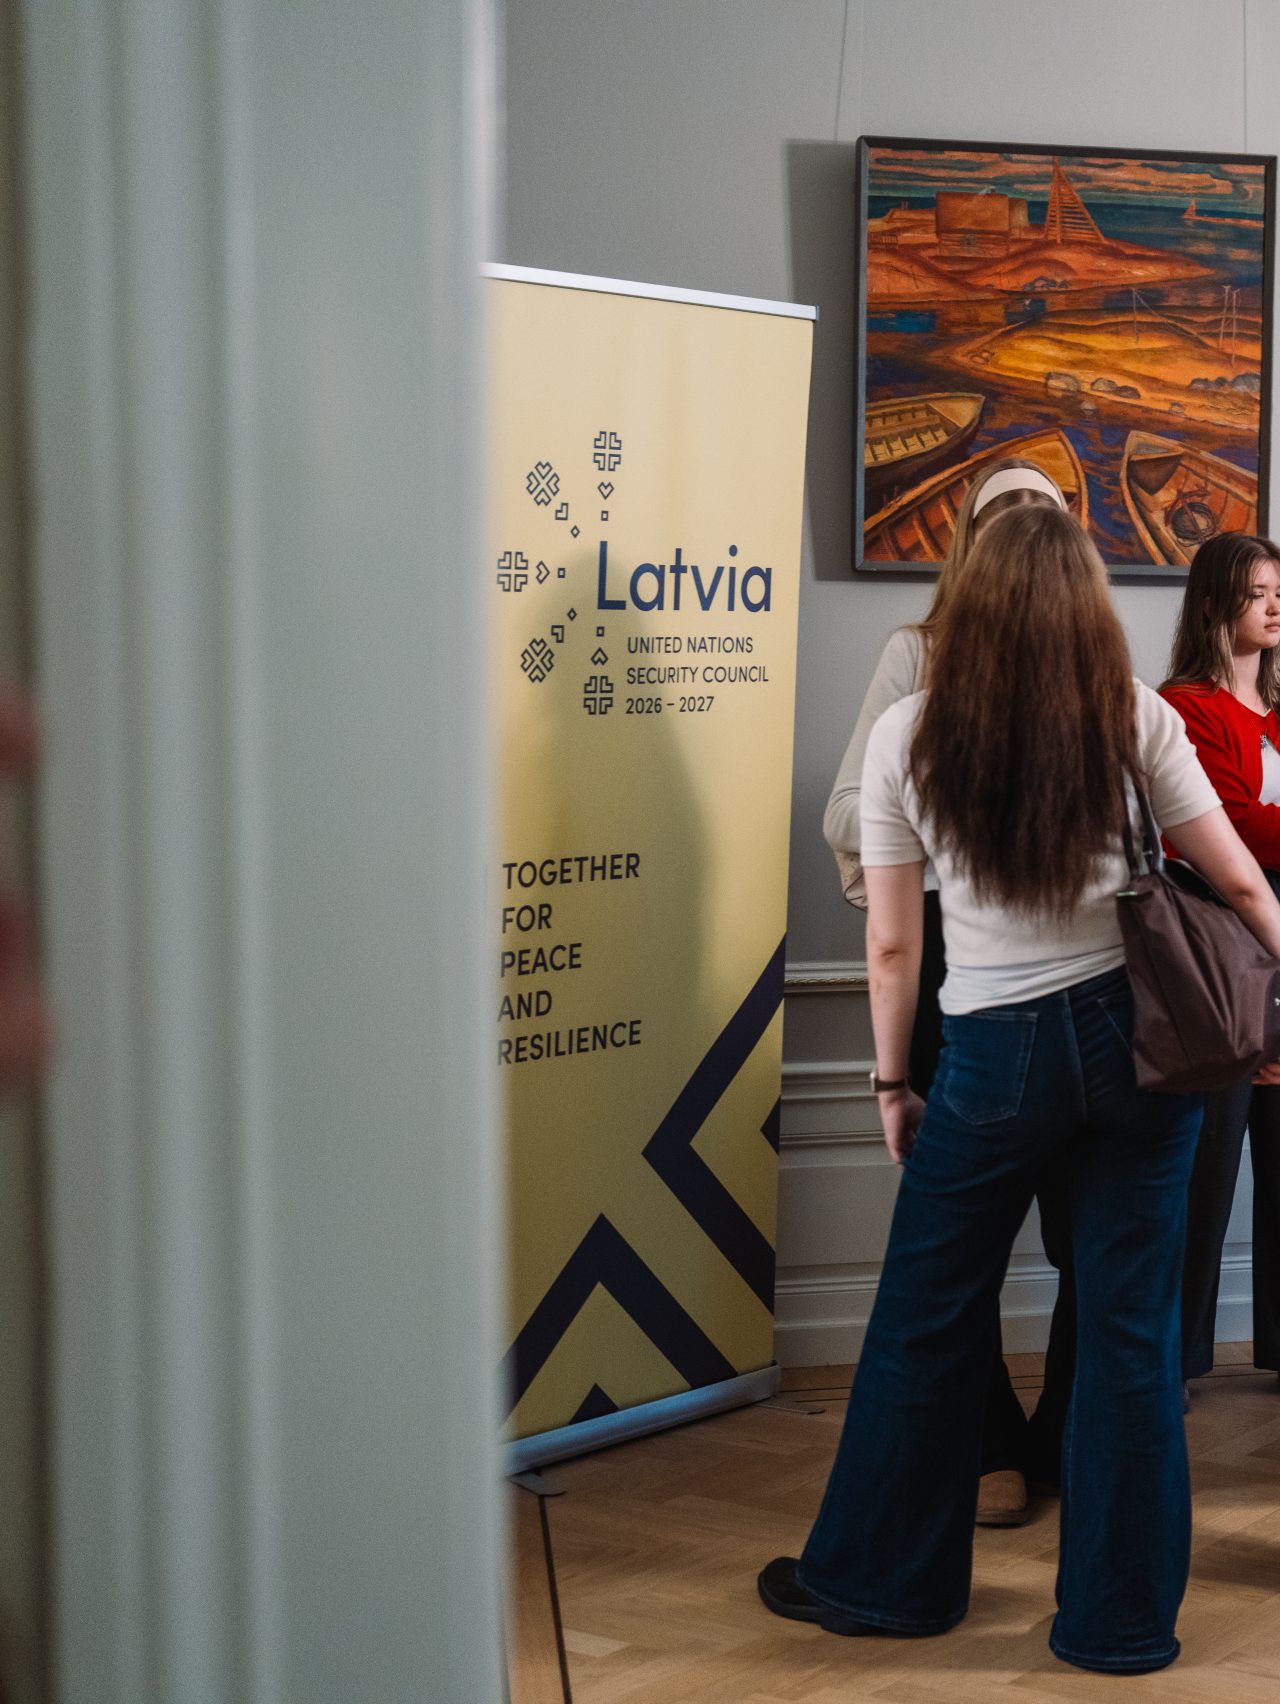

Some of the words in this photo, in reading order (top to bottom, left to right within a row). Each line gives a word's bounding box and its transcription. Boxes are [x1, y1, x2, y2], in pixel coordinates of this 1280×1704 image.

[597, 540, 772, 612] Latvia
[627, 636, 683, 653] UNITED
[687, 636, 753, 653] NATIONS
[626, 667, 699, 684] SECURITY
[702, 666, 769, 683] COUNCIL
[625, 698, 662, 714] 2026
[679, 696, 714, 712] 2027
[502, 853, 640, 889] TOGETHER
[502, 903, 553, 934] FOR
[501, 943, 582, 978] PEACE
[497, 990, 552, 1021] AND
[497, 1020, 642, 1065] RESILIENCE
